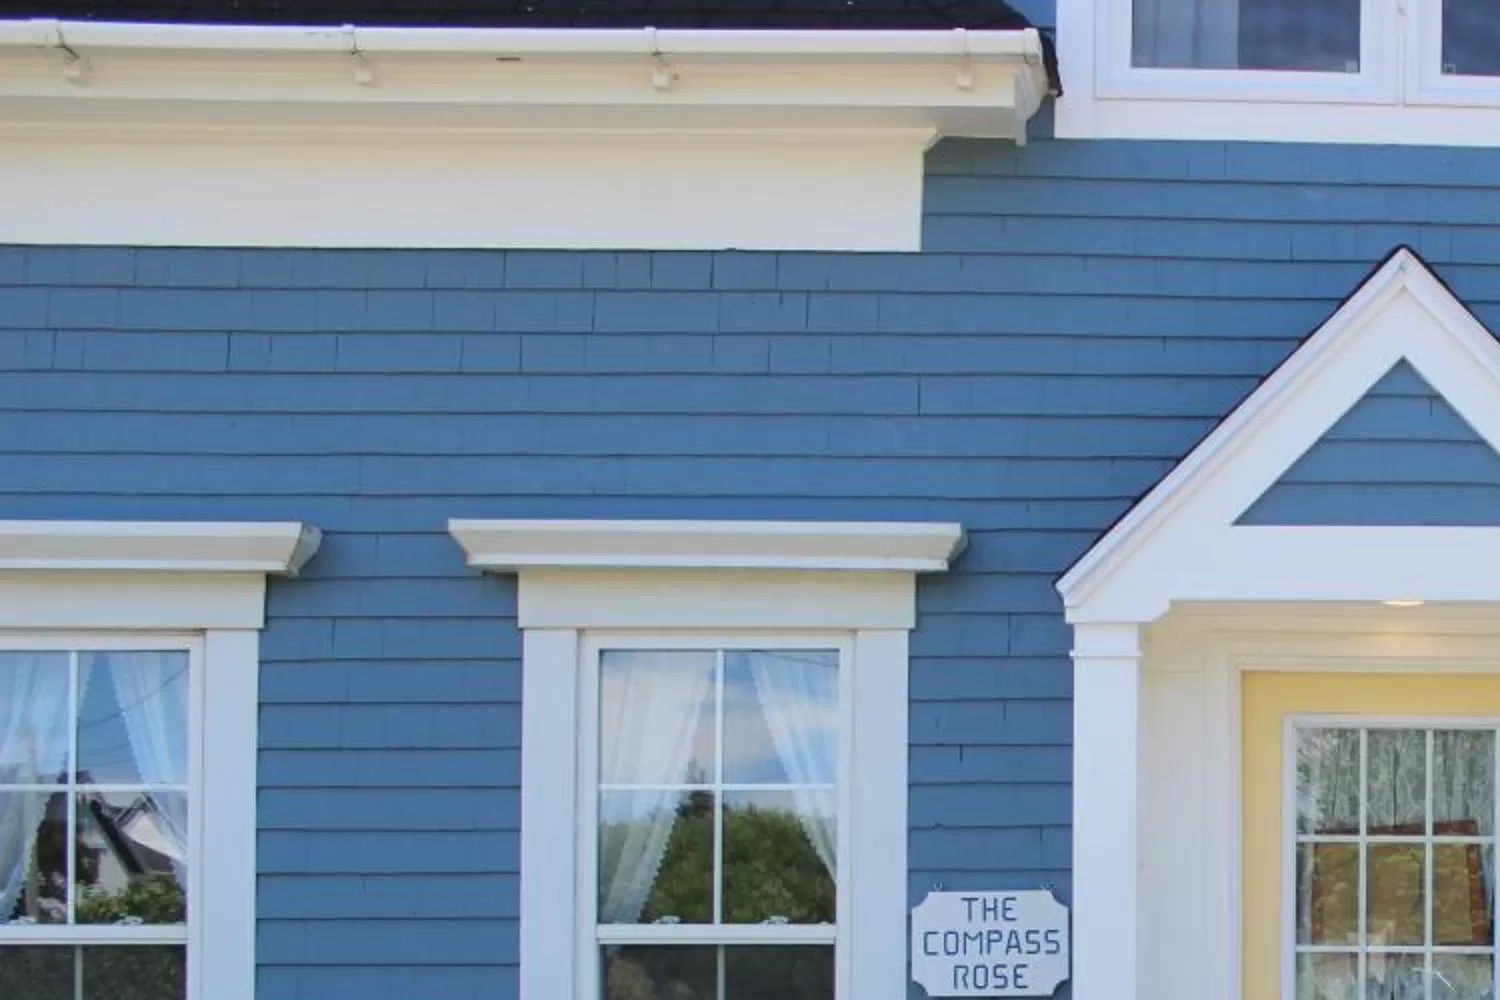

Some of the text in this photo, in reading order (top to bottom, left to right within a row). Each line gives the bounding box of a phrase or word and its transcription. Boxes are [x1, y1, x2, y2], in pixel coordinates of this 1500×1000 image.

[960, 897, 1018, 922] THE
[923, 929, 1061, 956] COMPASS
[953, 963, 1029, 990] ROSE
